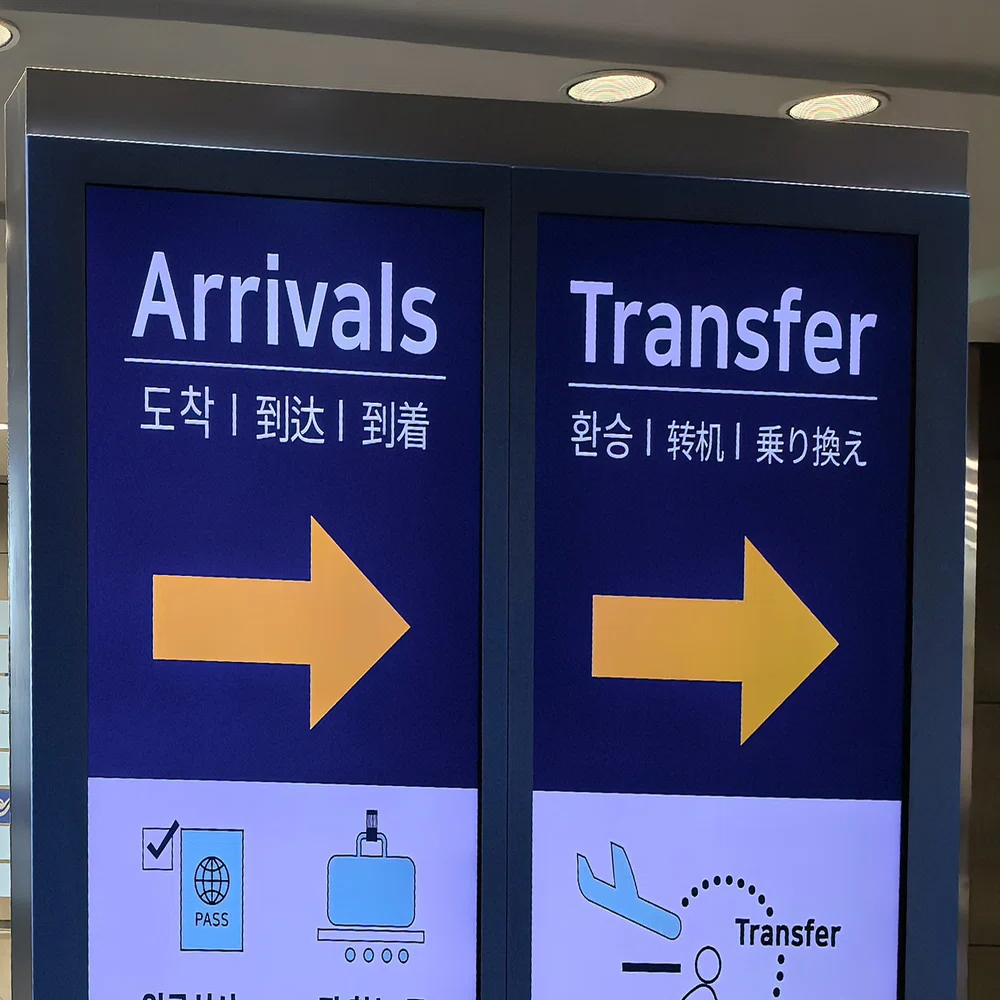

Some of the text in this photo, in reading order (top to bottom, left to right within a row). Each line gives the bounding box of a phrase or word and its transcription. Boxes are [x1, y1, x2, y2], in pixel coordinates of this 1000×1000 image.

[131, 251, 438, 355] Arrivals
[569, 279, 878, 376] Transfer
[139, 384, 430, 450] 도착 到达 到着
[570, 410, 868, 468] 환승 转机 乗り換え
[195, 912, 229, 927] PASS
[735, 918, 841, 948] Transfer
